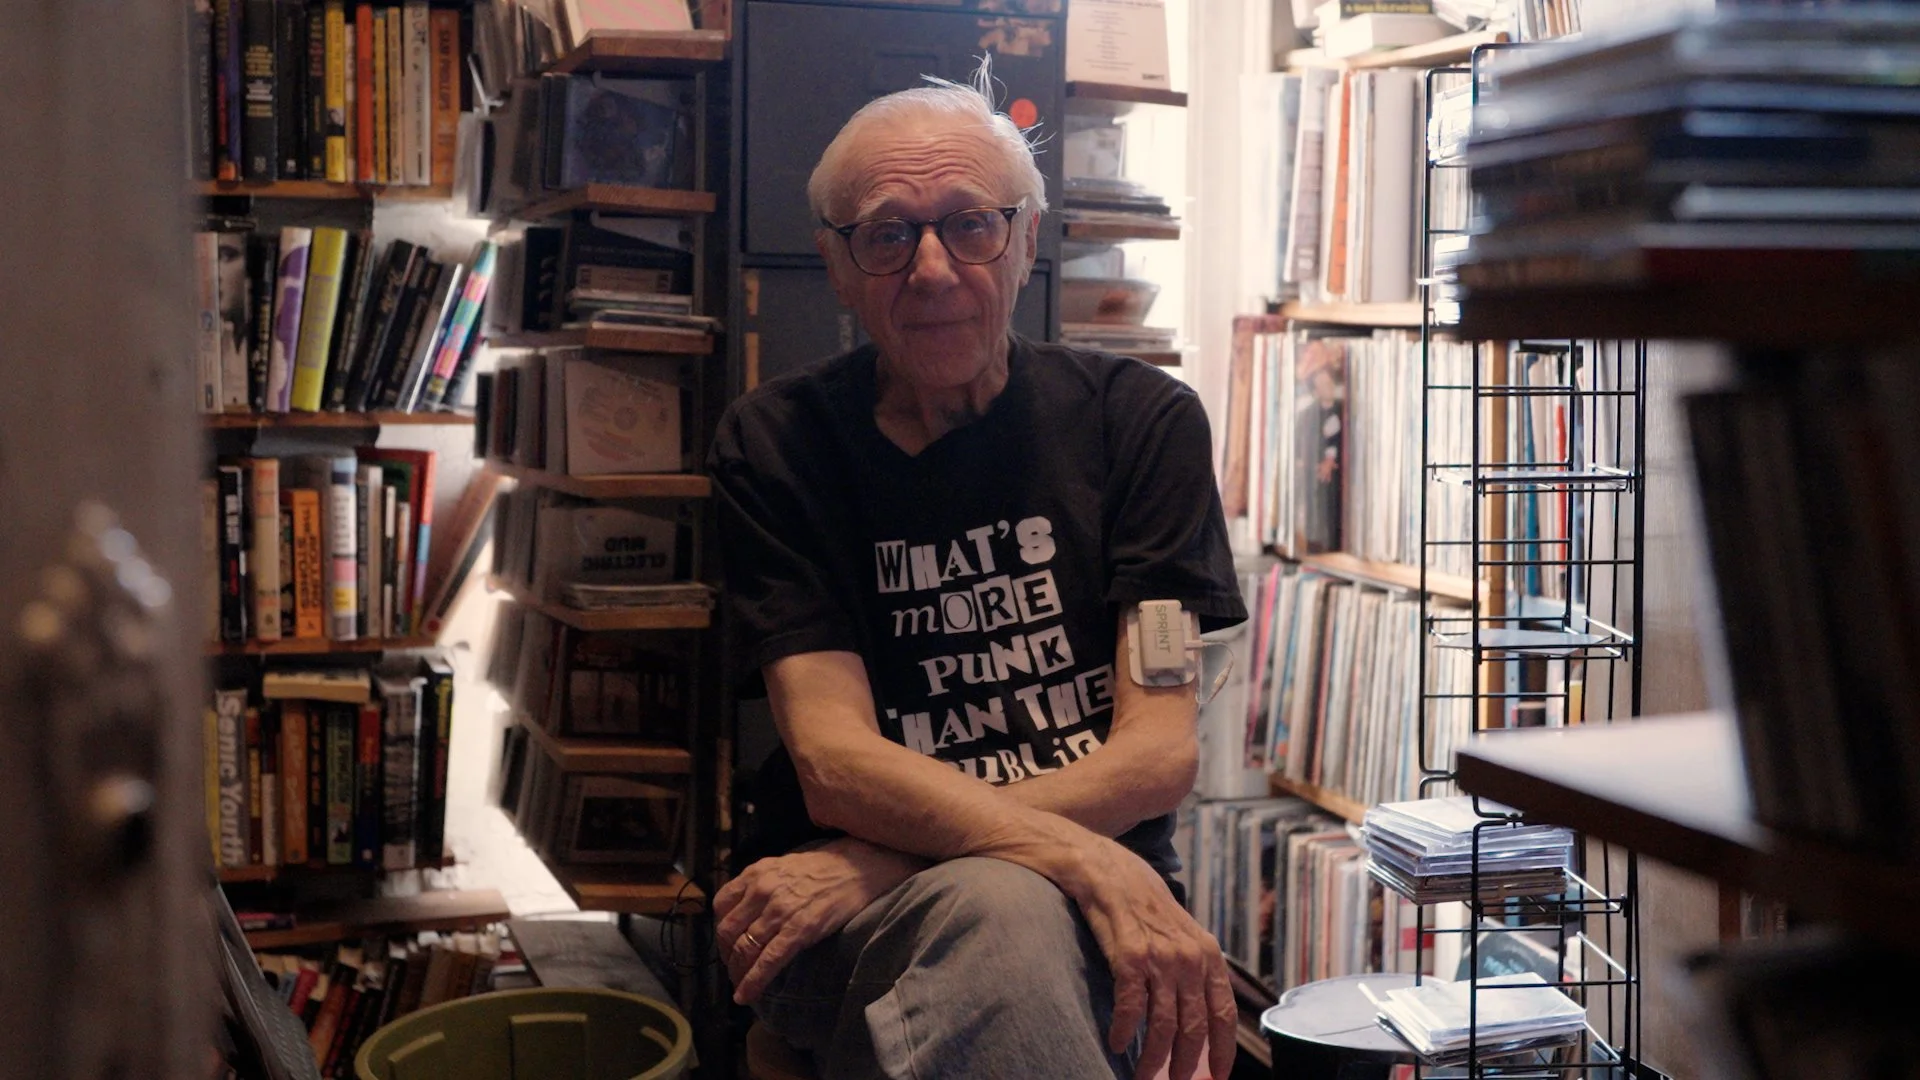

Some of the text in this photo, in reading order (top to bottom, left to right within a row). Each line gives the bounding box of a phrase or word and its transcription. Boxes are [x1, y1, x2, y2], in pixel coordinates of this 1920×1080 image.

[875, 516, 1056, 593] WHAT'S
[1155, 604, 1171, 653] SPRINT
[886, 664, 1115, 755] HAN THE
